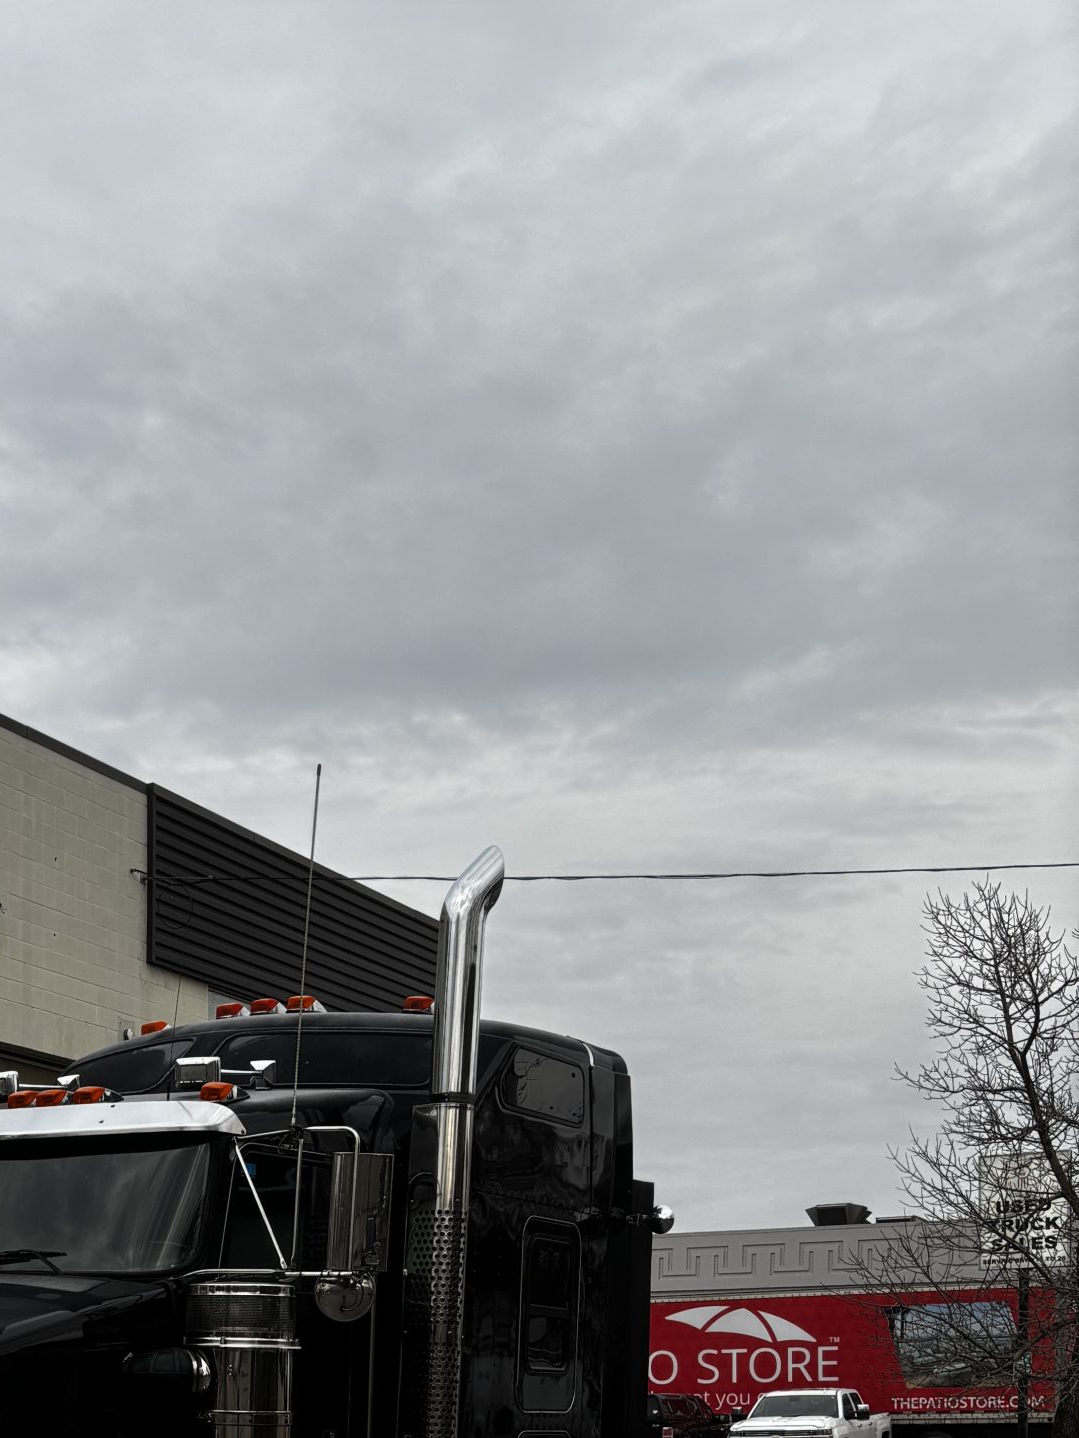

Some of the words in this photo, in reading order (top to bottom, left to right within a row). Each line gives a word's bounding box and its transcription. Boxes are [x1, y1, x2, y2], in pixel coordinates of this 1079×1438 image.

[996, 1199, 1051, 1213] USED
[987, 1217, 1061, 1233] TRUCK
[697, 1346, 839, 1384] STORE
[715, 1392, 750, 1410] you
[891, 1395, 1046, 1409] THEPATIOSTORE.CM
